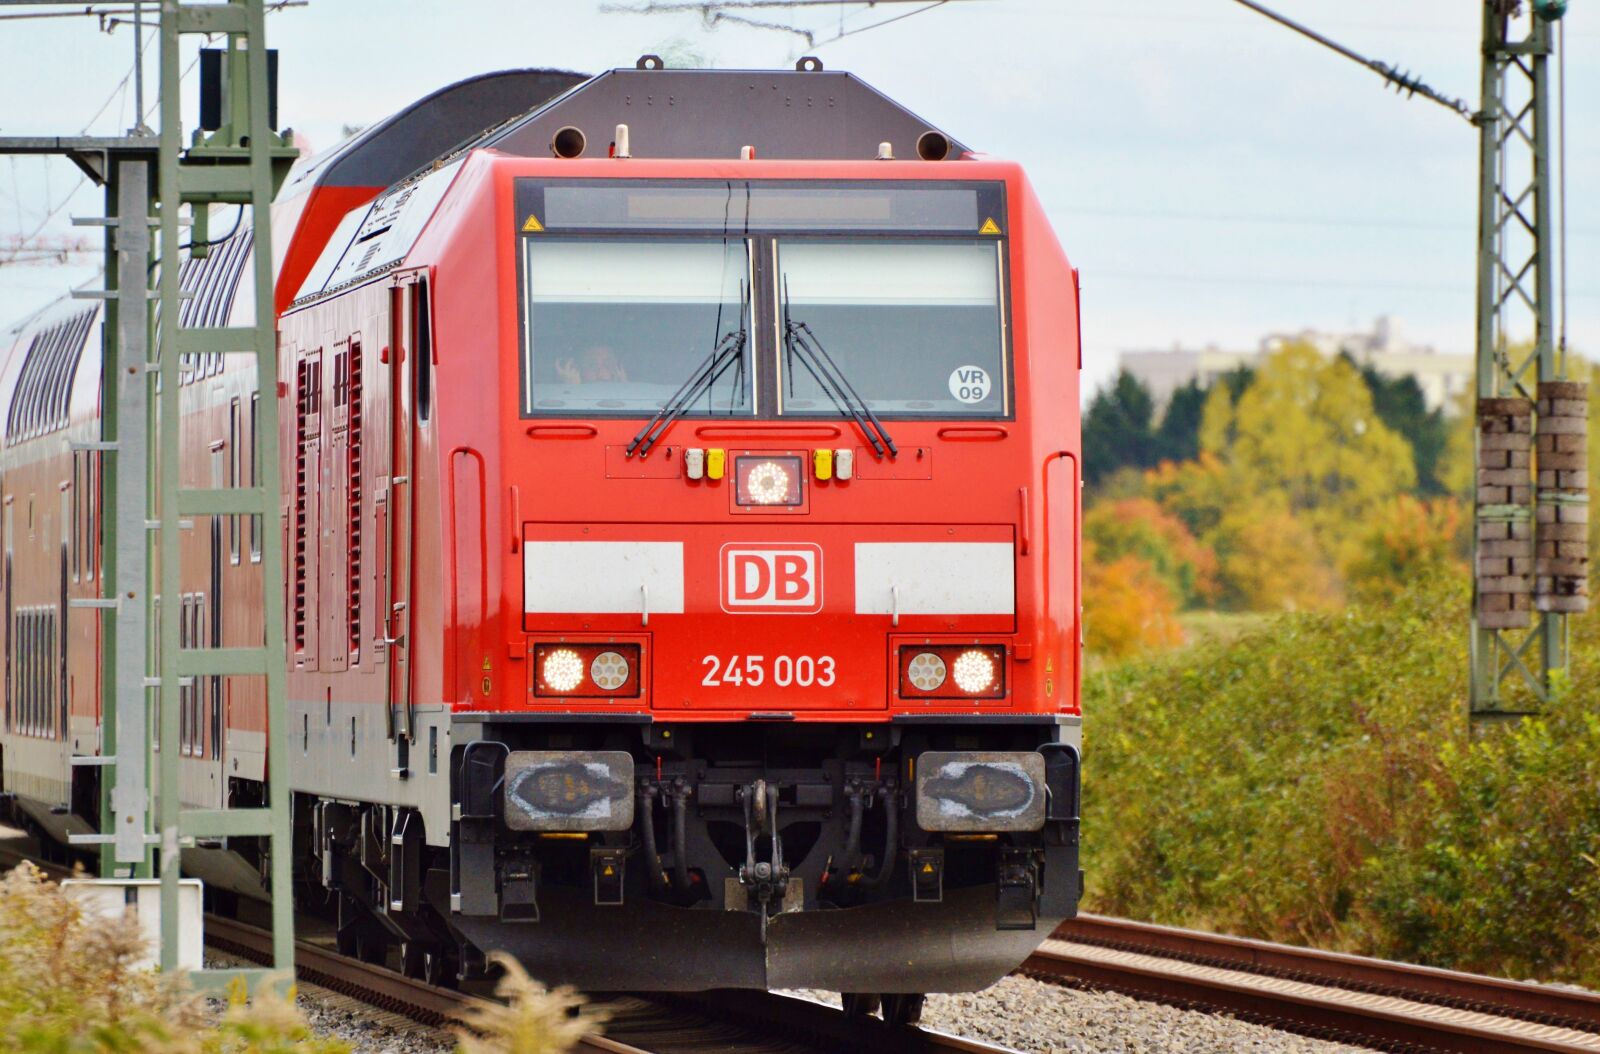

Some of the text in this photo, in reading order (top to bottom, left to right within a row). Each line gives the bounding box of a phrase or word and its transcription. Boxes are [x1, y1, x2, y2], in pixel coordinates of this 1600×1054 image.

[957, 370, 984, 384] VR
[959, 386, 983, 400] 09
[734, 555, 810, 601] DB
[701, 655, 836, 687] 245 003
